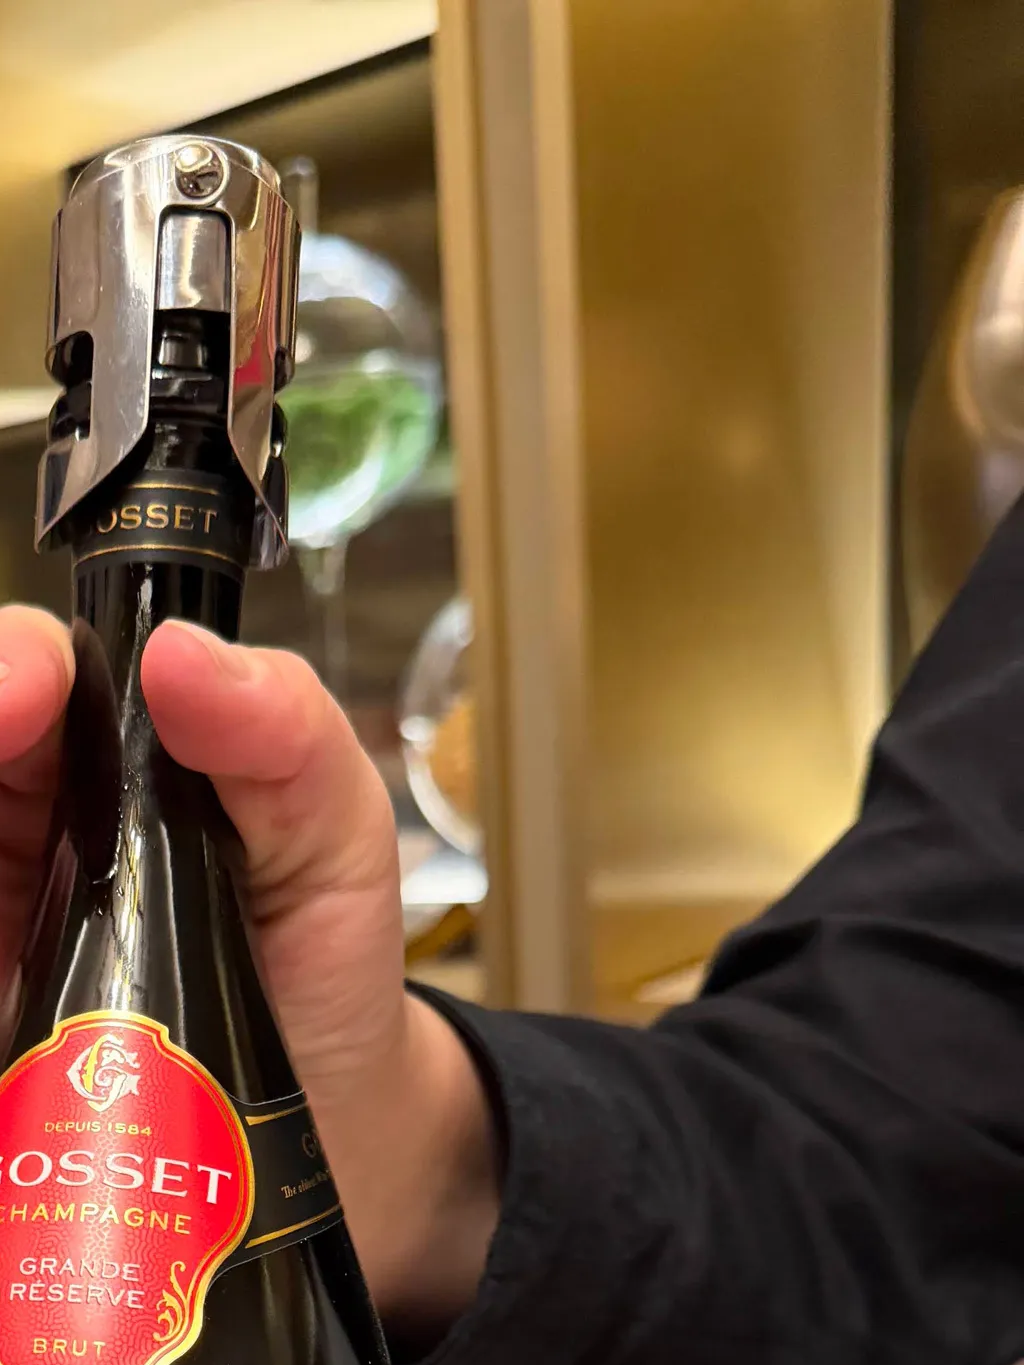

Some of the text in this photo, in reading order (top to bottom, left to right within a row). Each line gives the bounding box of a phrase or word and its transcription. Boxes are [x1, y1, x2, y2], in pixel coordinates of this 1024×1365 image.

[95, 503, 218, 535] OSSET
[44, 1120, 152, 1137] DEPUIS 1584
[19, 1256, 142, 1283] GRANDE
[9, 1278, 146, 1309] RÉSERVE
[32, 1337, 107, 1359] BRUT
